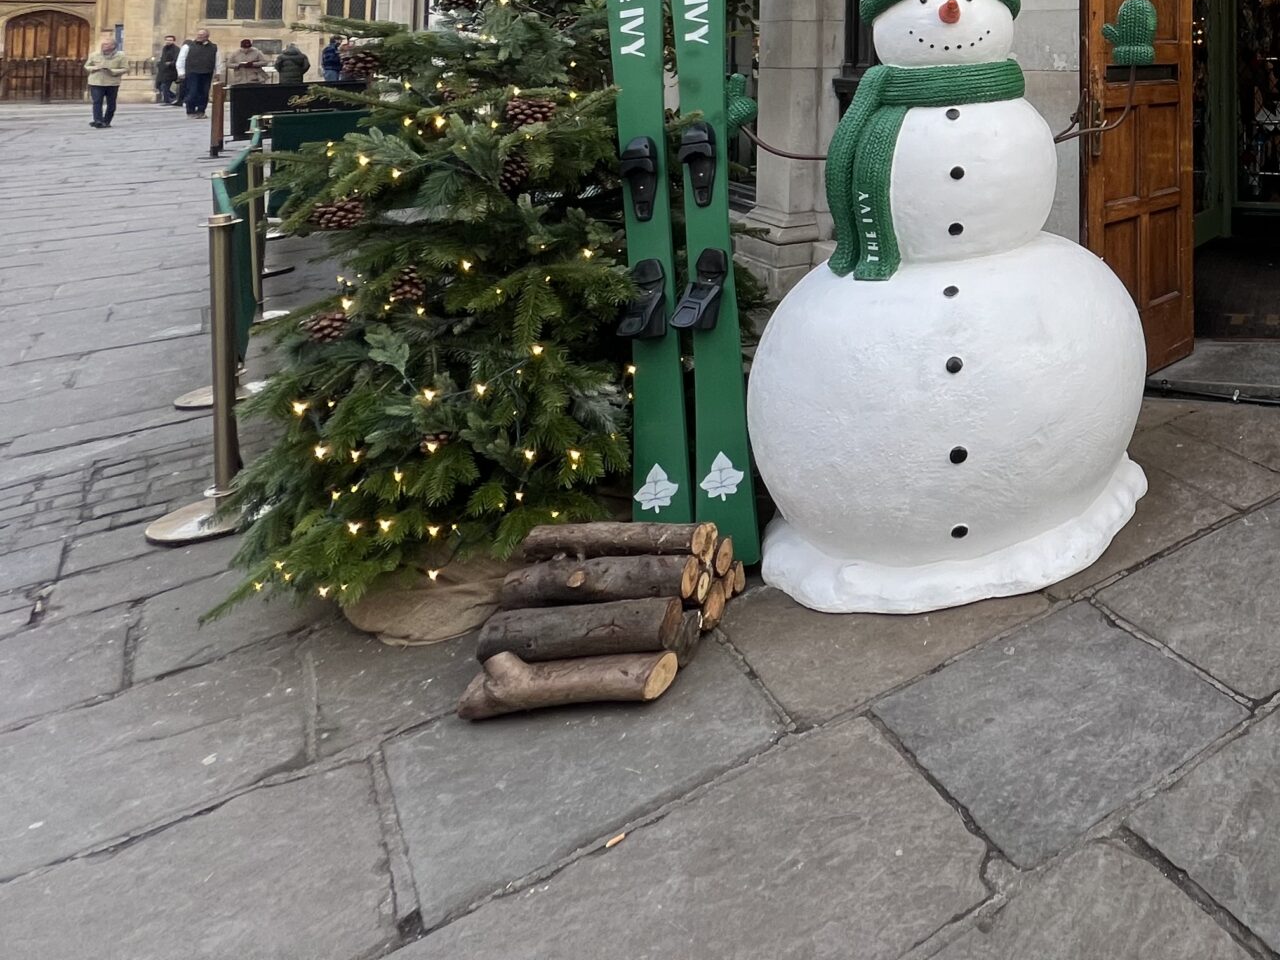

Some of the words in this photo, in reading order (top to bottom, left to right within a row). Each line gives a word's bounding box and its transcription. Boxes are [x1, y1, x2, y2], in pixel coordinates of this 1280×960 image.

[619, 7, 646, 58] IVY
[858, 191, 873, 223] IVY
[865, 231, 879, 263] THE
